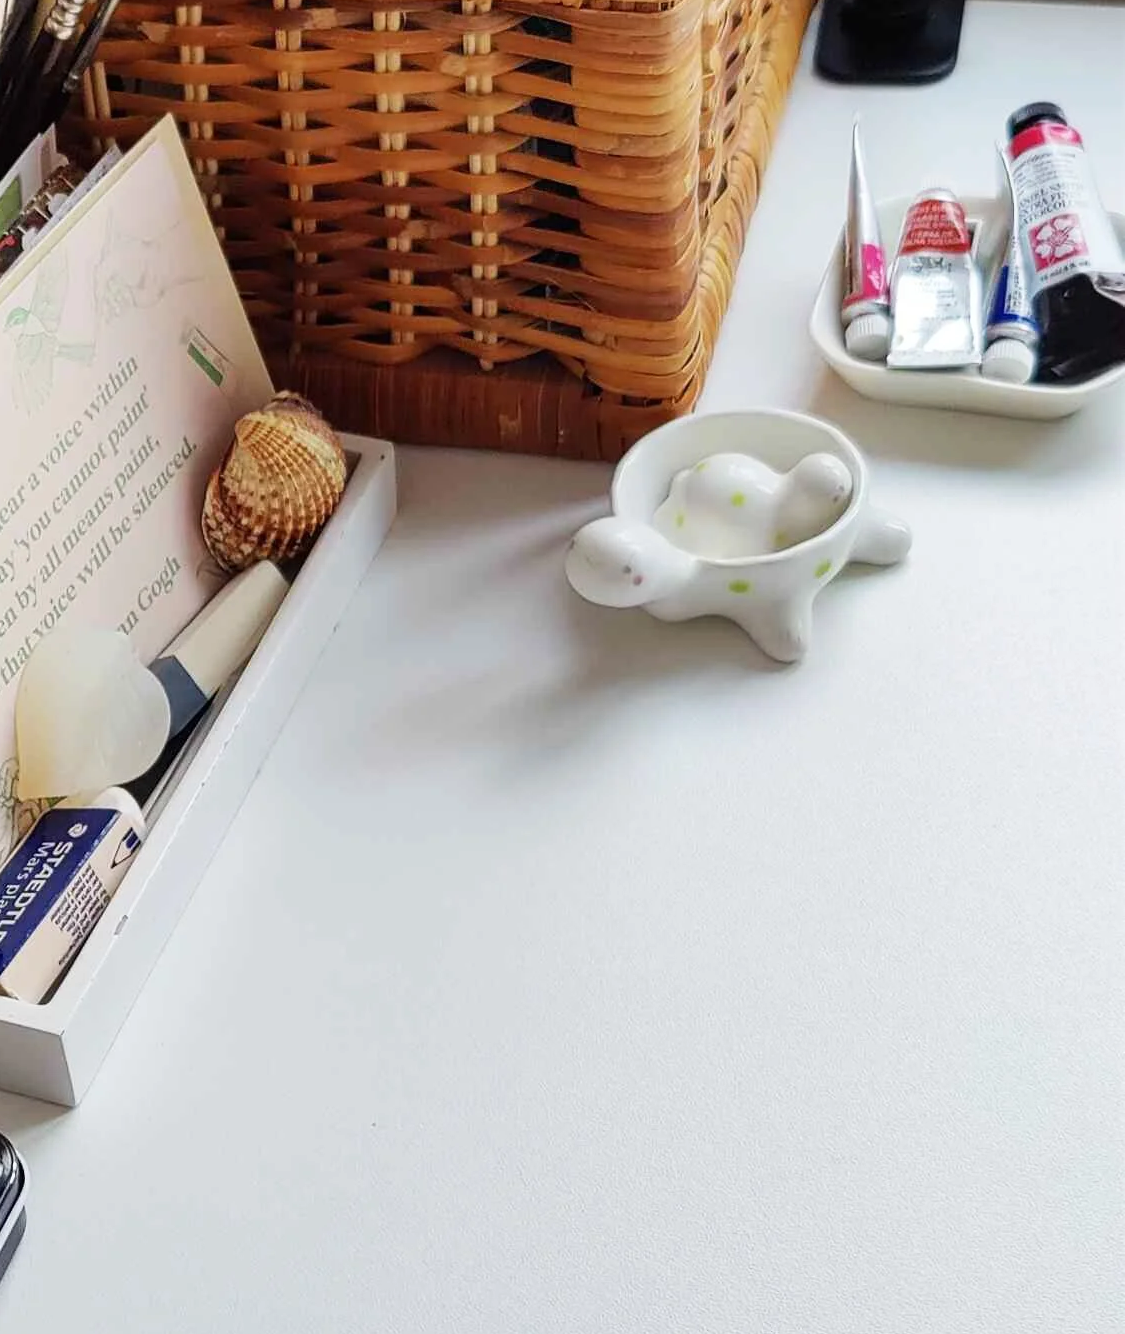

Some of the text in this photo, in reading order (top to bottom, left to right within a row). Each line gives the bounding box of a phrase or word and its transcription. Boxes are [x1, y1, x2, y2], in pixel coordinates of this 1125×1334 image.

[27, 472, 40, 491] a
[38, 420, 83, 473] voice
[83, 356, 138, 421] within
[15, 576, 38, 610] by
[39, 544, 62, 584] all
[62, 486, 114, 556] means
[114, 435, 161, 499] paint,
[52, 441, 107, 514] cannot
[0, 635, 36, 685] that
[32, 584, 76, 637] voice
[76, 536, 112, 584] will
[108, 515, 131, 546] be
[131, 436, 197, 521] silenced.
[137, 556, 181, 611] Gogh
[17, 841, 50, 881] Mars
